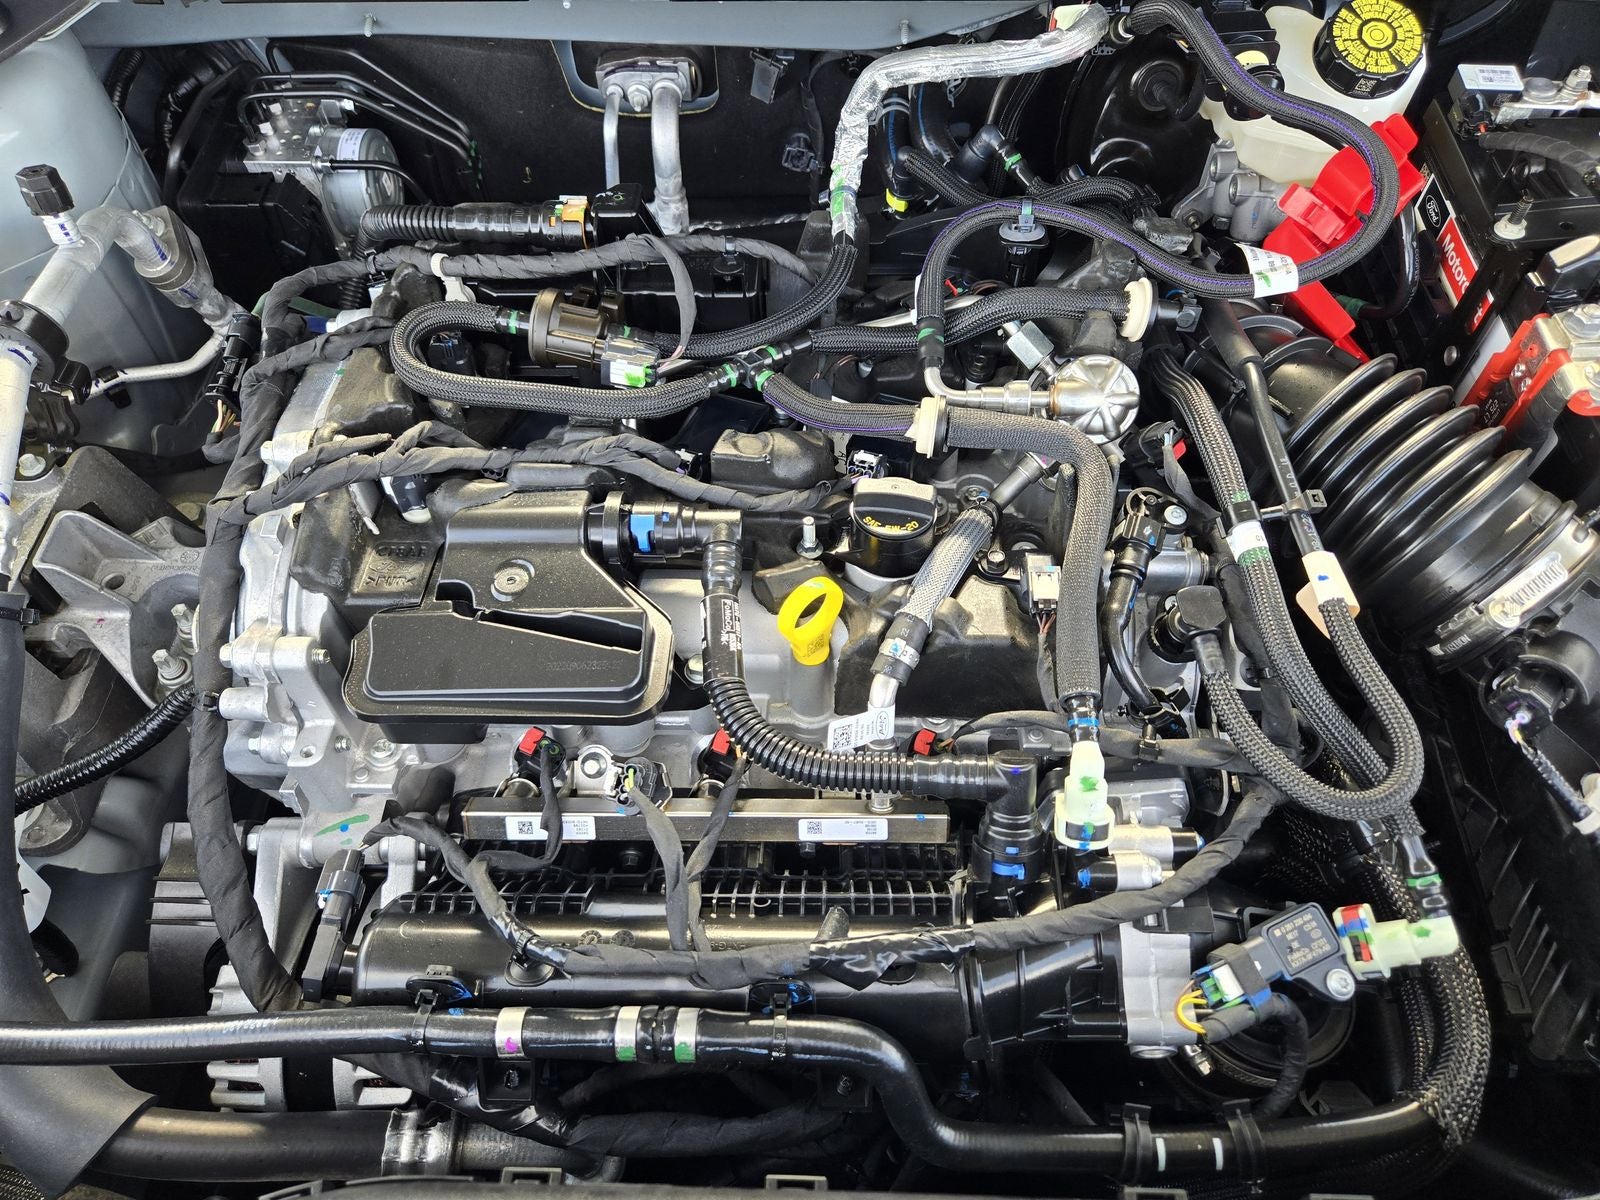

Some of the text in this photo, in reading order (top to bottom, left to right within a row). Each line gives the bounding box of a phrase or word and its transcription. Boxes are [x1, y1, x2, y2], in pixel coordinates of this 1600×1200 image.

[1345, 53, 1365, 69] SEALED
[1426, 197, 1440, 226] Ford
[723, 599, 733, 631] FoMoCo
